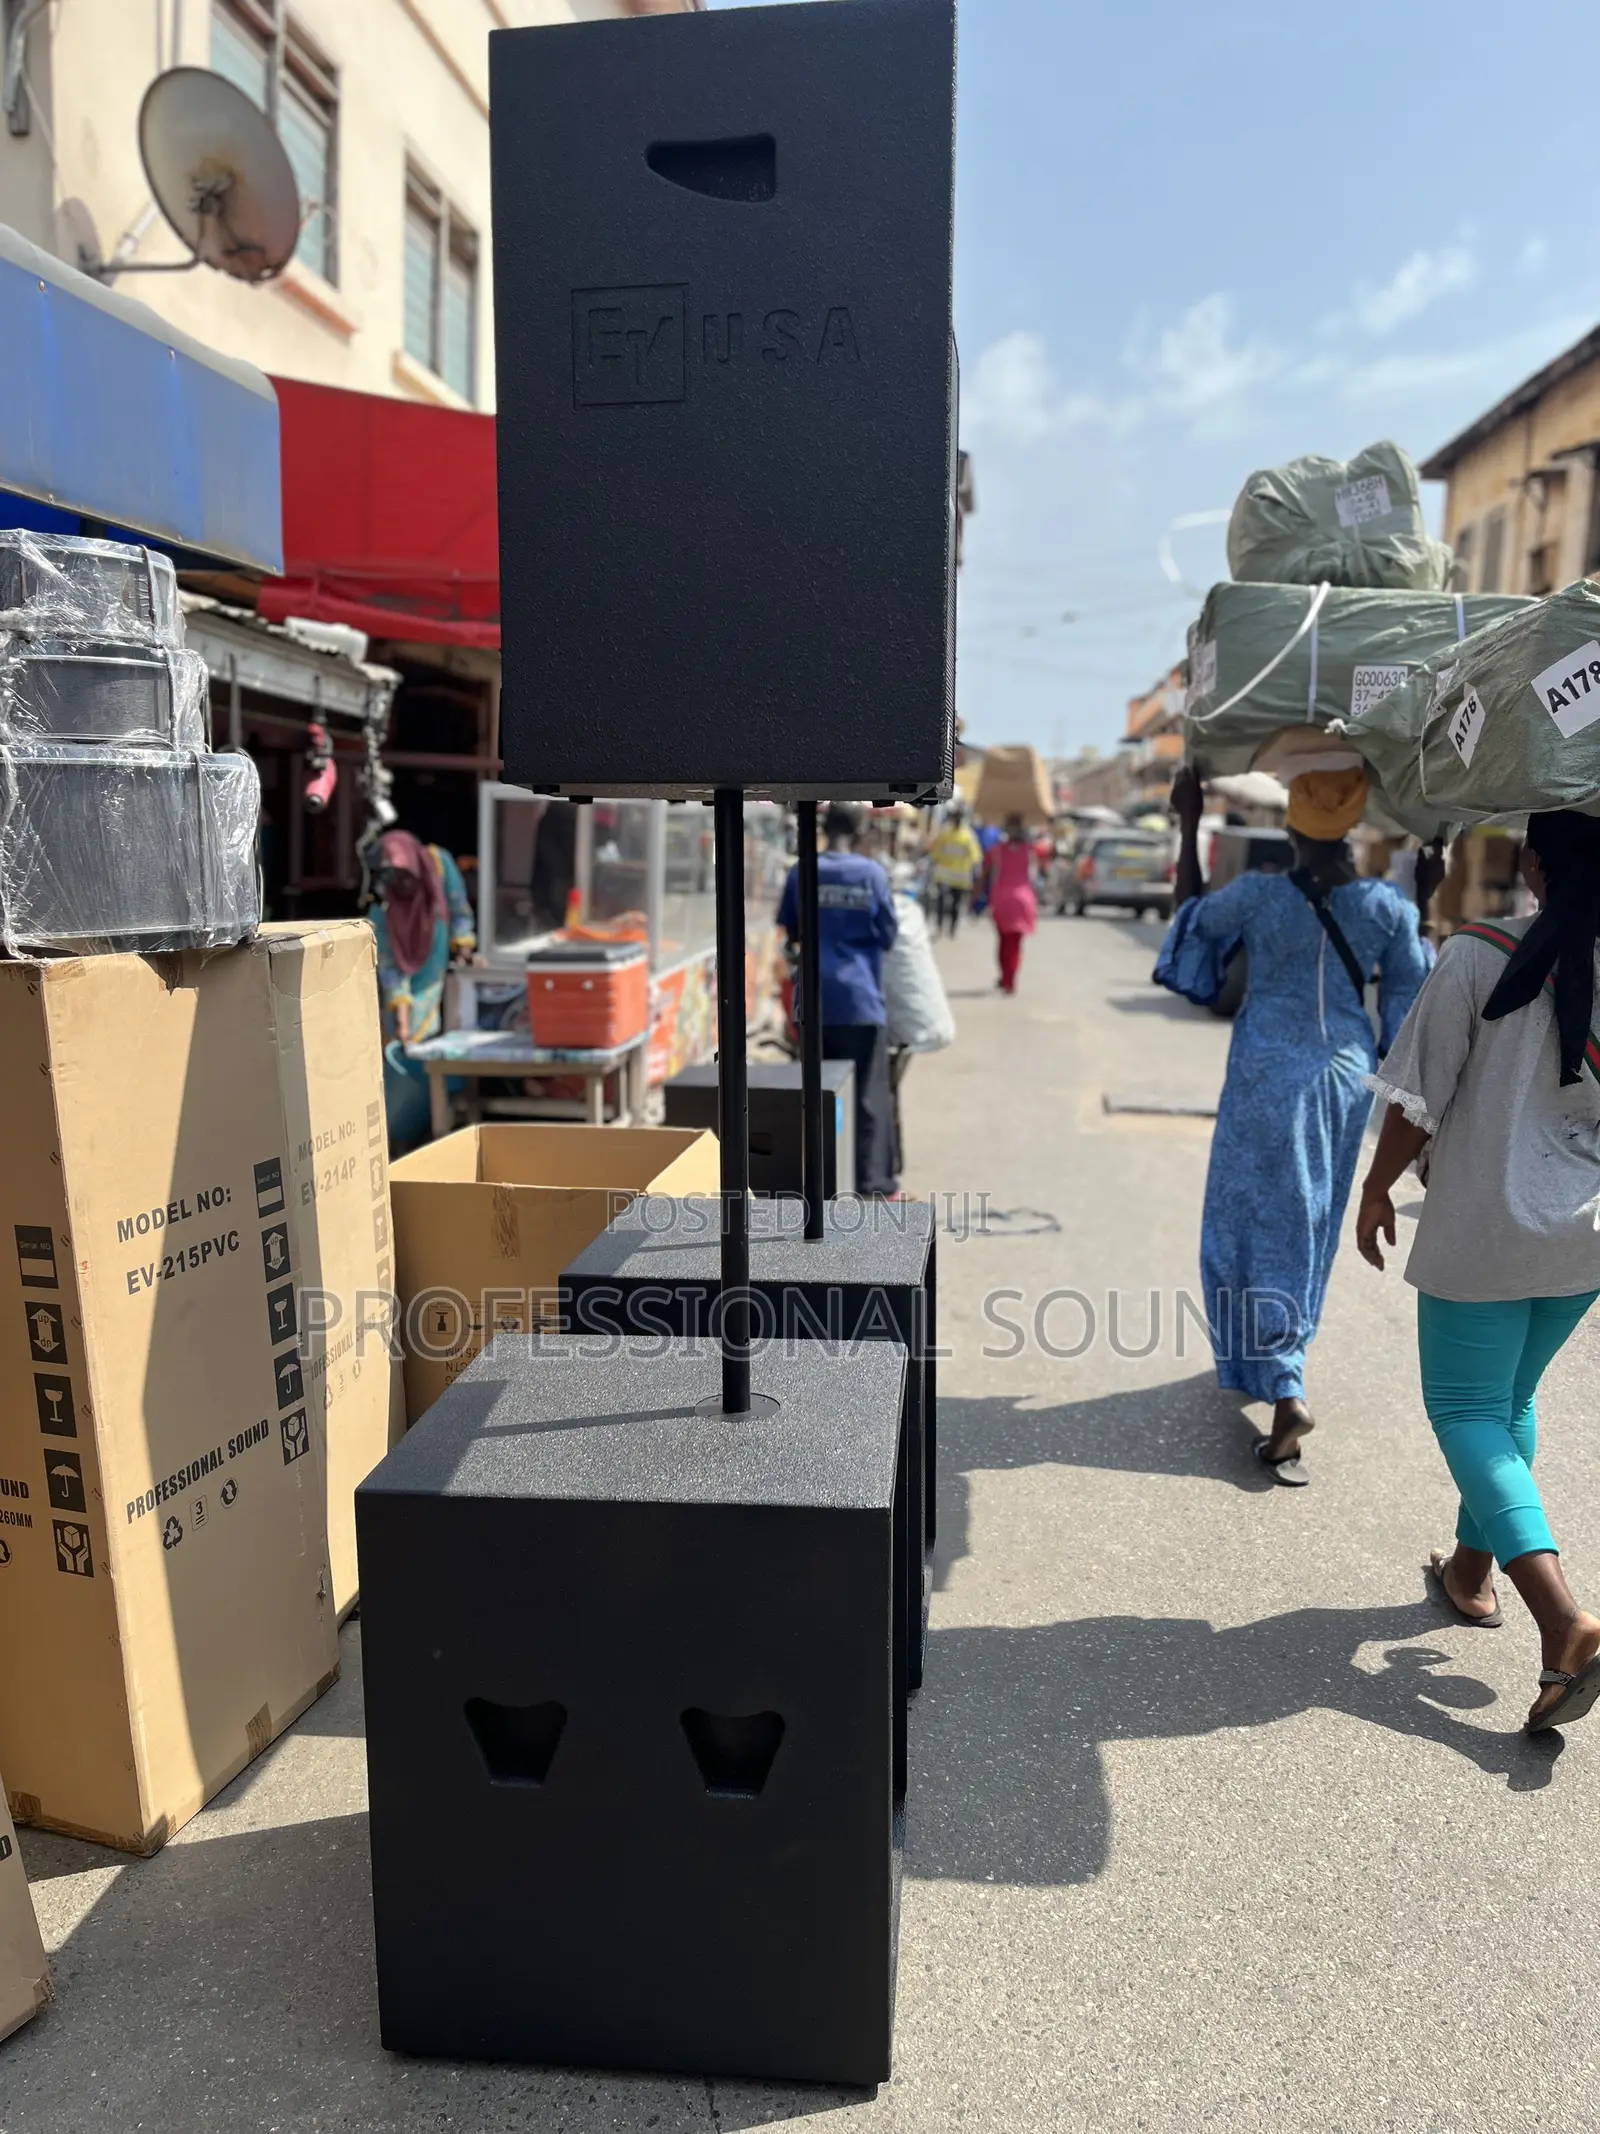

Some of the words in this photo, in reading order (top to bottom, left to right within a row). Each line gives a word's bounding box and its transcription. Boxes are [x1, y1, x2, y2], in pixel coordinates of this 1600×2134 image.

[702, 305, 861, 367] USA
[1354, 689, 1392, 702] 37-4
[1546, 660, 1600, 714] A178
[1454, 695, 1477, 752] A178
[298, 1130, 337, 1163] MODEL
[300, 1156, 356, 1207] EV-214P
[116, 1199, 193, 1244] MODEL
[196, 1186, 232, 1214] NO:
[126, 1230, 240, 1296] EV-215PVC
[126, 1446, 225, 1525] PROFESSIONAL
[227, 1419, 270, 1459] SOUND
